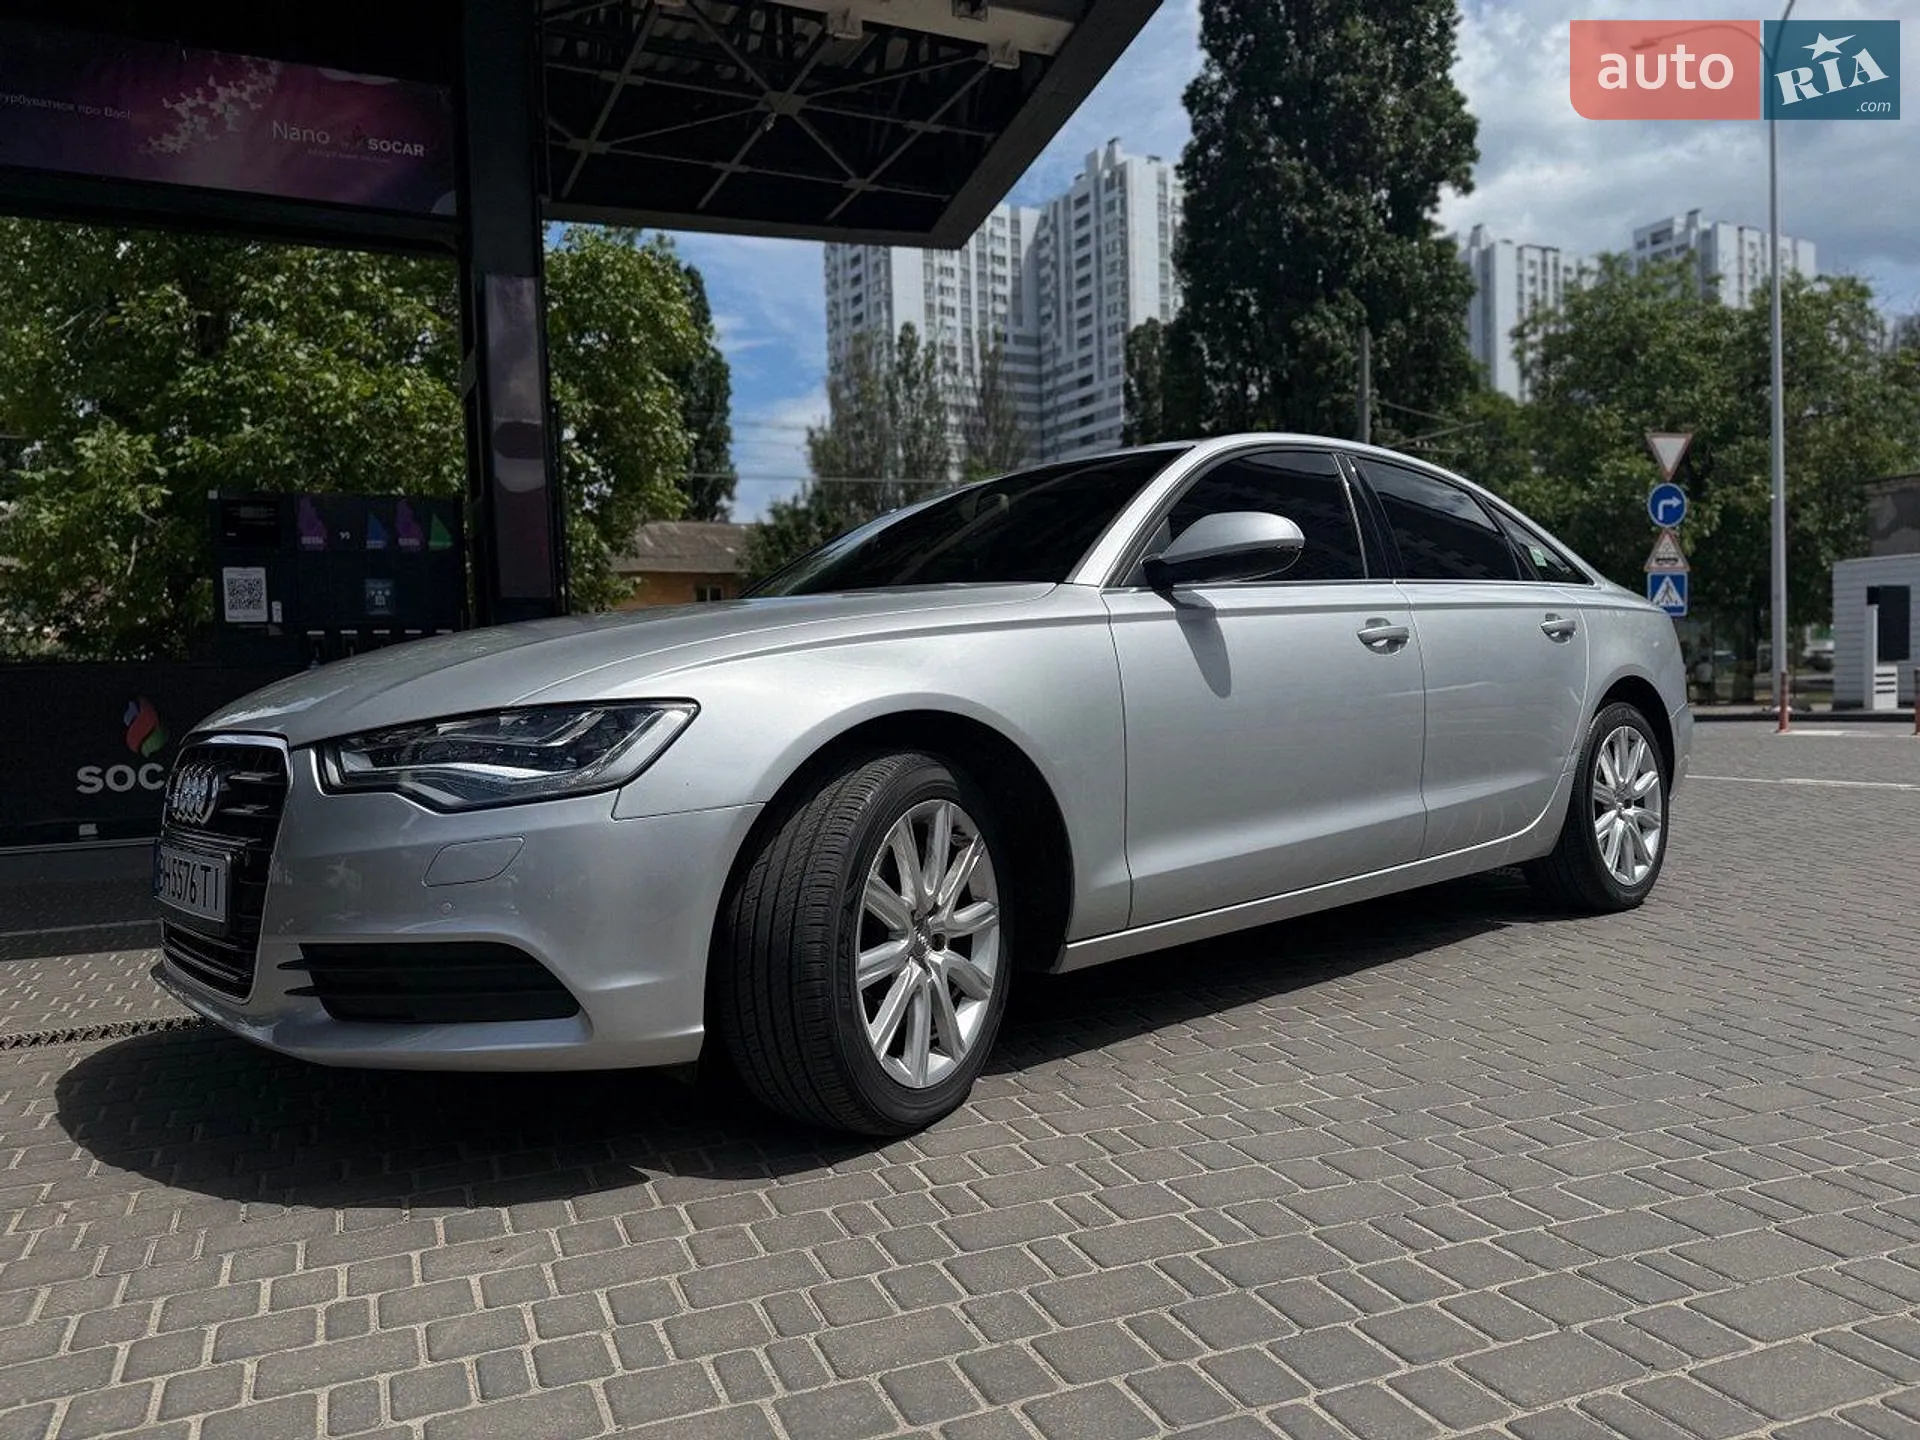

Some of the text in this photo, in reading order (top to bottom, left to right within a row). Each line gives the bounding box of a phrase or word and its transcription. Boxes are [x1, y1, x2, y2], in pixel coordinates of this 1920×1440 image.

[272, 119, 330, 145] Nano
[367, 137, 425, 158] SOCAR
[76, 762, 165, 794] SOC
